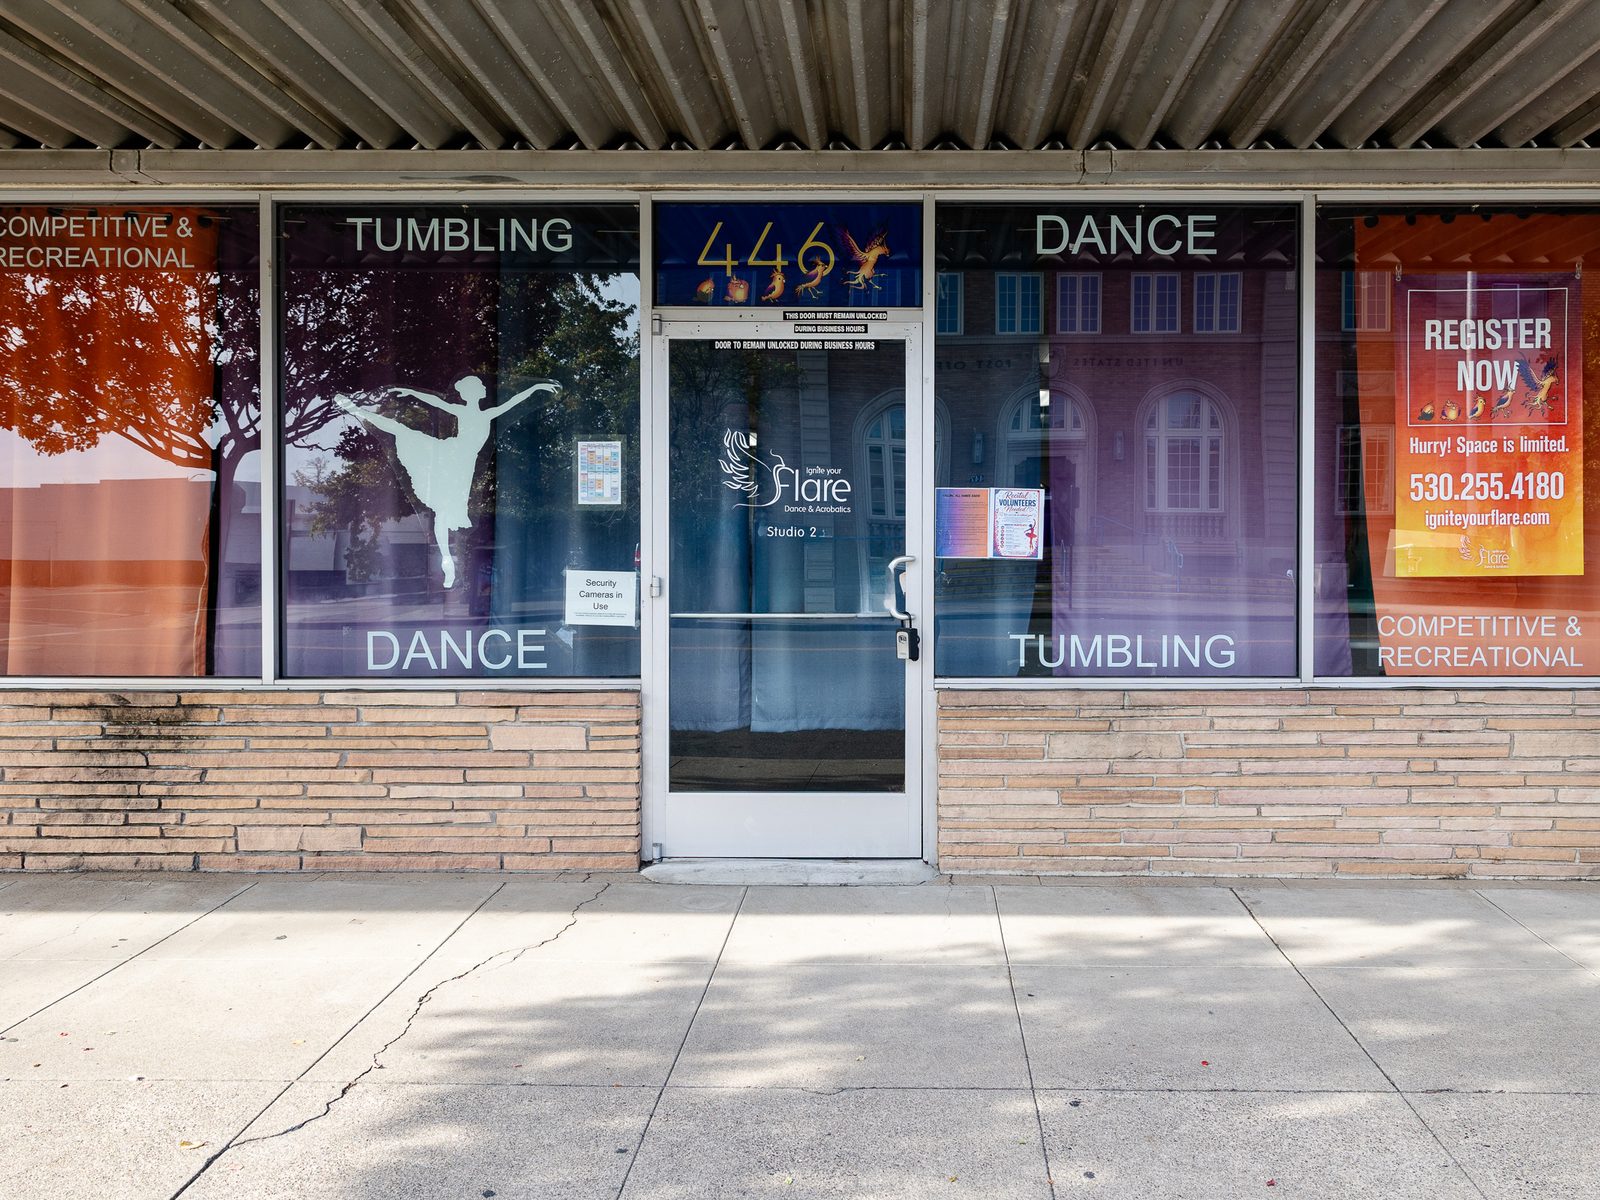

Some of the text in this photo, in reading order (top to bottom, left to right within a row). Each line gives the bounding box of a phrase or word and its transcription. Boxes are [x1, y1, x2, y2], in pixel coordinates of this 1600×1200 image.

[176, 216, 194, 237] &
[346, 217, 574, 252] TUMBLING
[1036, 214, 1218, 256] DANCE
[697, 221, 835, 277] 446
[785, 312, 887, 320] THIS DOOR MUST REMAIN UNLOCKED
[794, 325, 866, 333] DURING BUSINESS HOURS
[1424, 318, 1552, 350] REGISTER
[714, 340, 875, 350] DOOR TO REMAIN UNLOCKED DURING BUSINESS HOURS
[1456, 359, 1519, 393] NOW
[1409, 435, 1569, 457] Hurry! Space is limited.
[806, 466, 842, 476] Ignite your
[1409, 471, 1565, 502] 530.255.4180
[784, 505, 807, 513] Dance
[815, 505, 851, 513] Acrobatics
[999, 499, 1037, 507] VOLUNTEERS
[1425, 509, 1550, 530] igniteyourflare.com
[766, 526, 817, 538] Studio 2
[585, 578, 617, 589] Security
[579, 590, 623, 599] Cameras in
[592, 602, 609, 611] Use
[1377, 615, 1583, 638] COMPETITIVE &
[366, 628, 547, 671] DANCE
[1009, 633, 1236, 669] TUMBLING
[1377, 645, 1584, 668] RECREATIONAL
